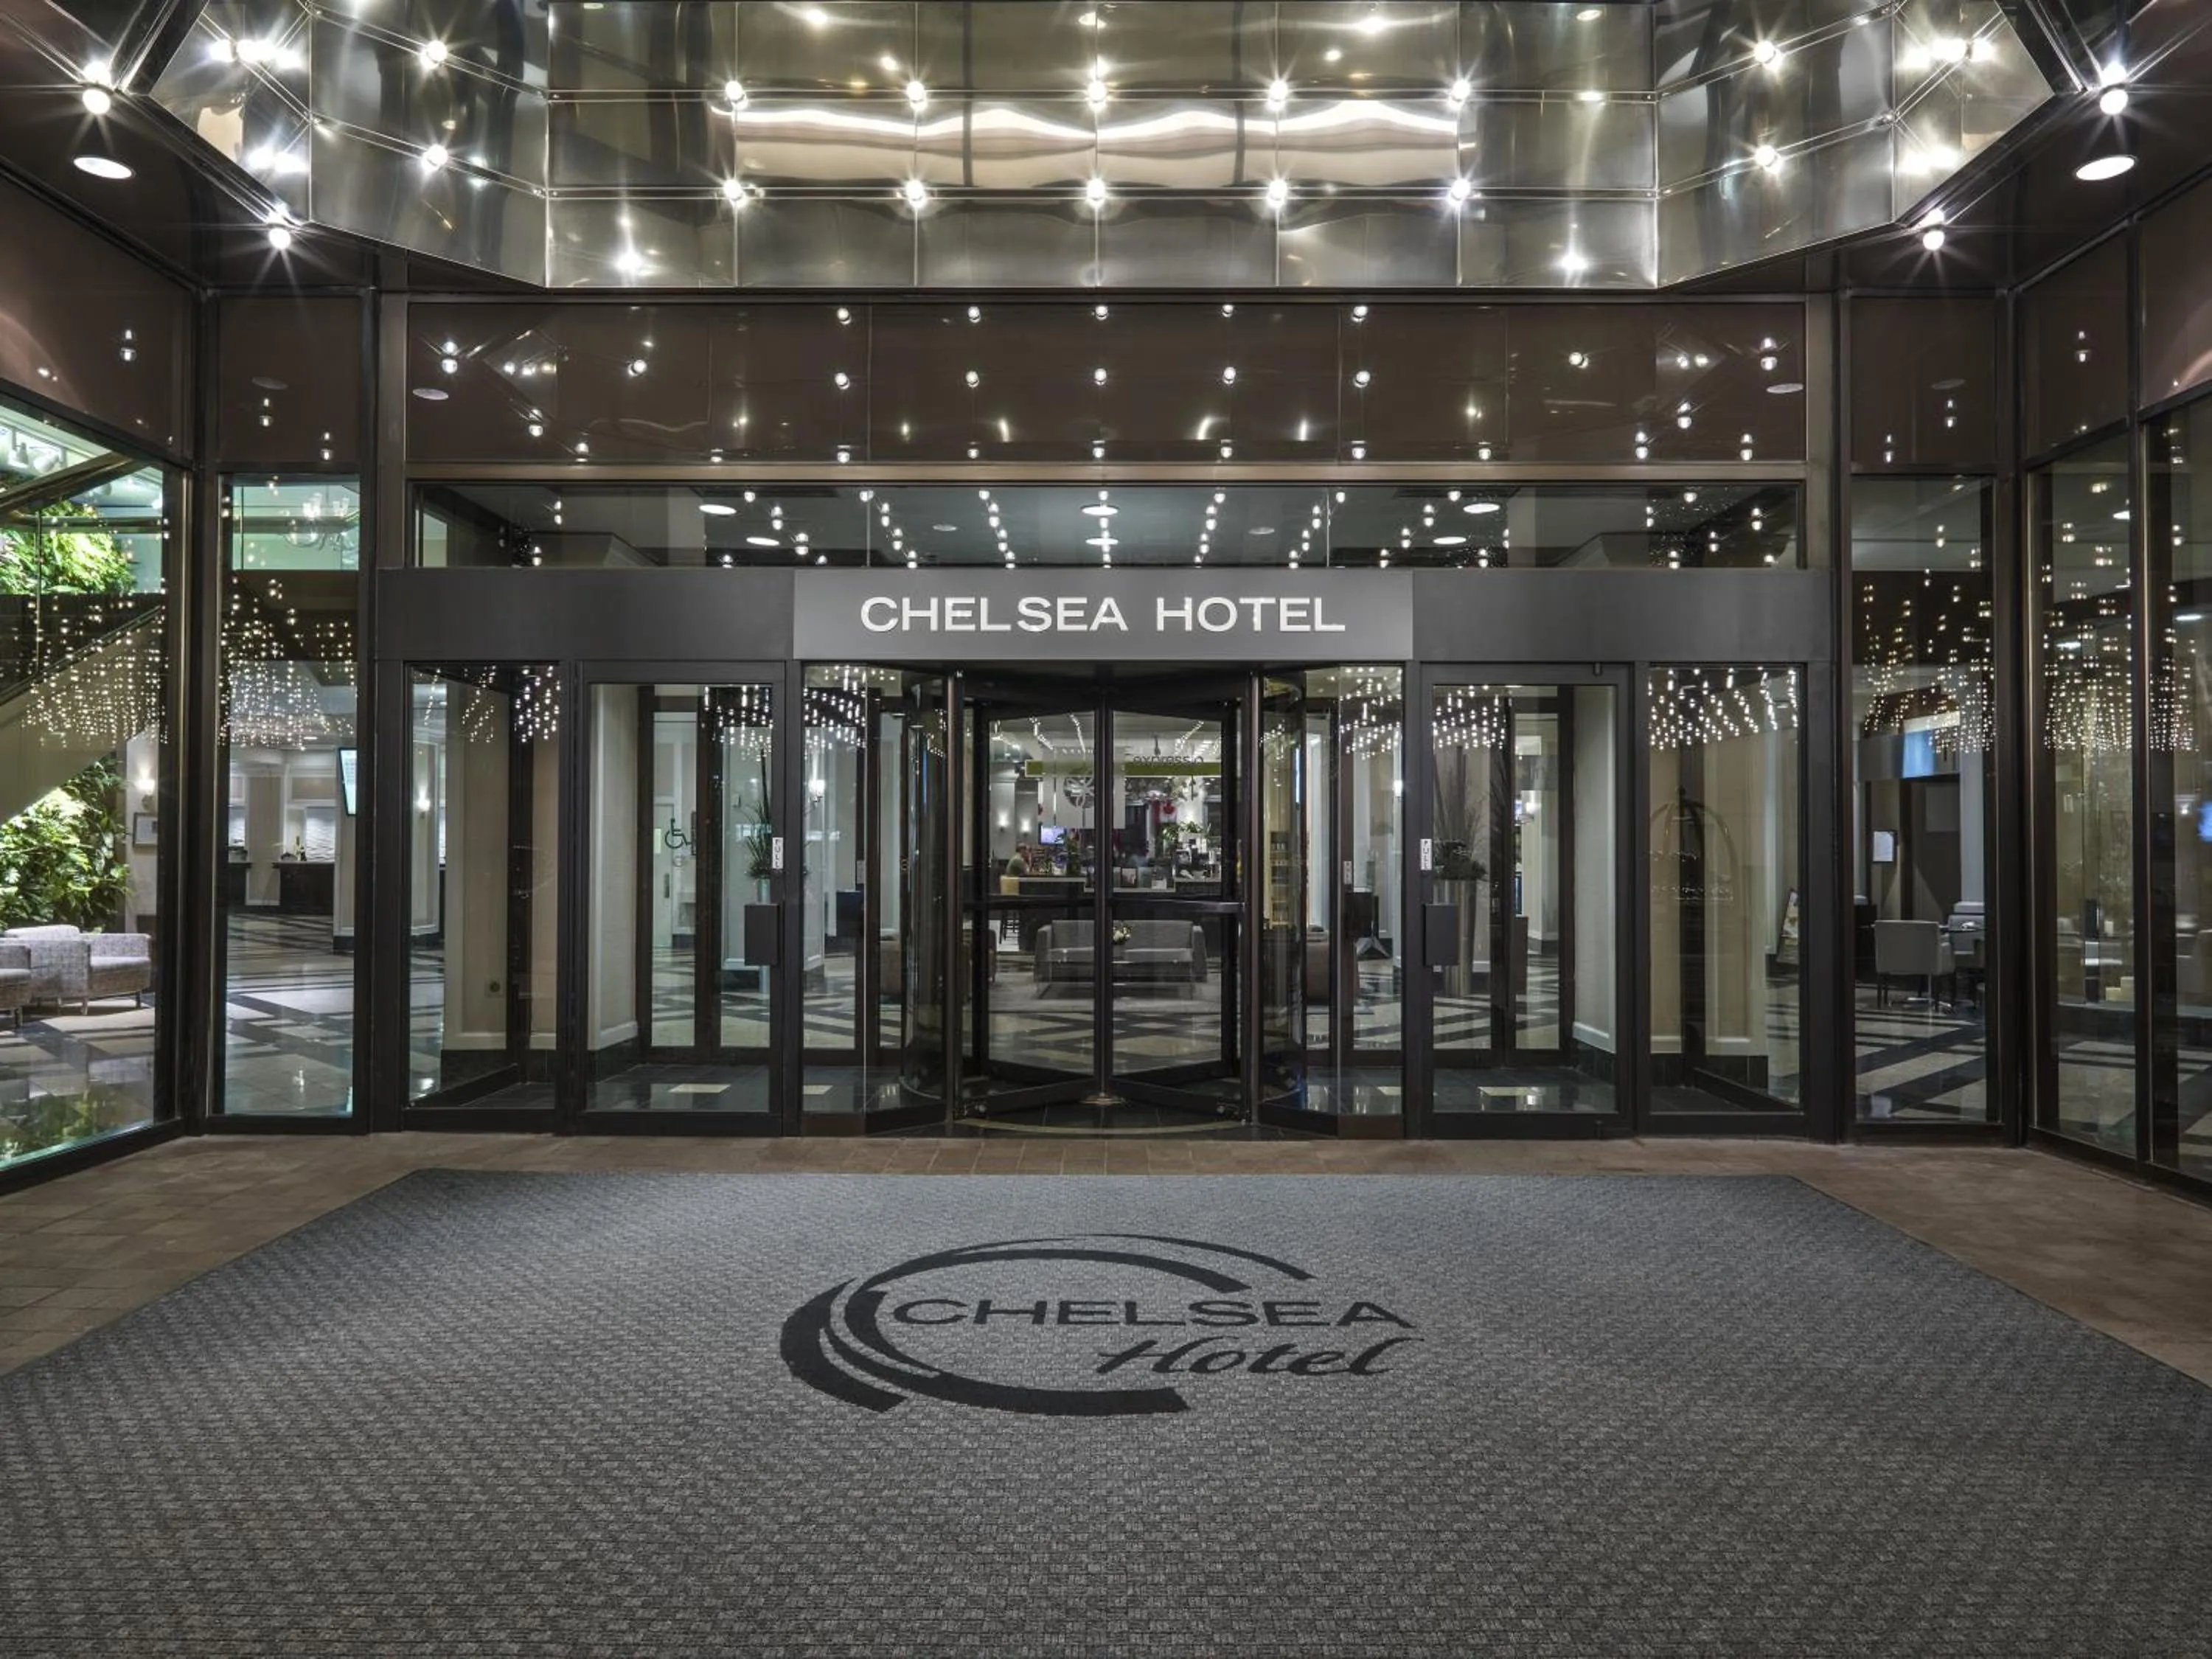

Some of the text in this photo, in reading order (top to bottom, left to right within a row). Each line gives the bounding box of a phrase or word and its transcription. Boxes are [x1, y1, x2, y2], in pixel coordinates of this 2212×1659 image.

[860, 597, 1346, 632] CHELSEA HOTEL
[893, 1298, 1417, 1328] CHELSEA
[1096, 1335, 1425, 1375] Hotel
